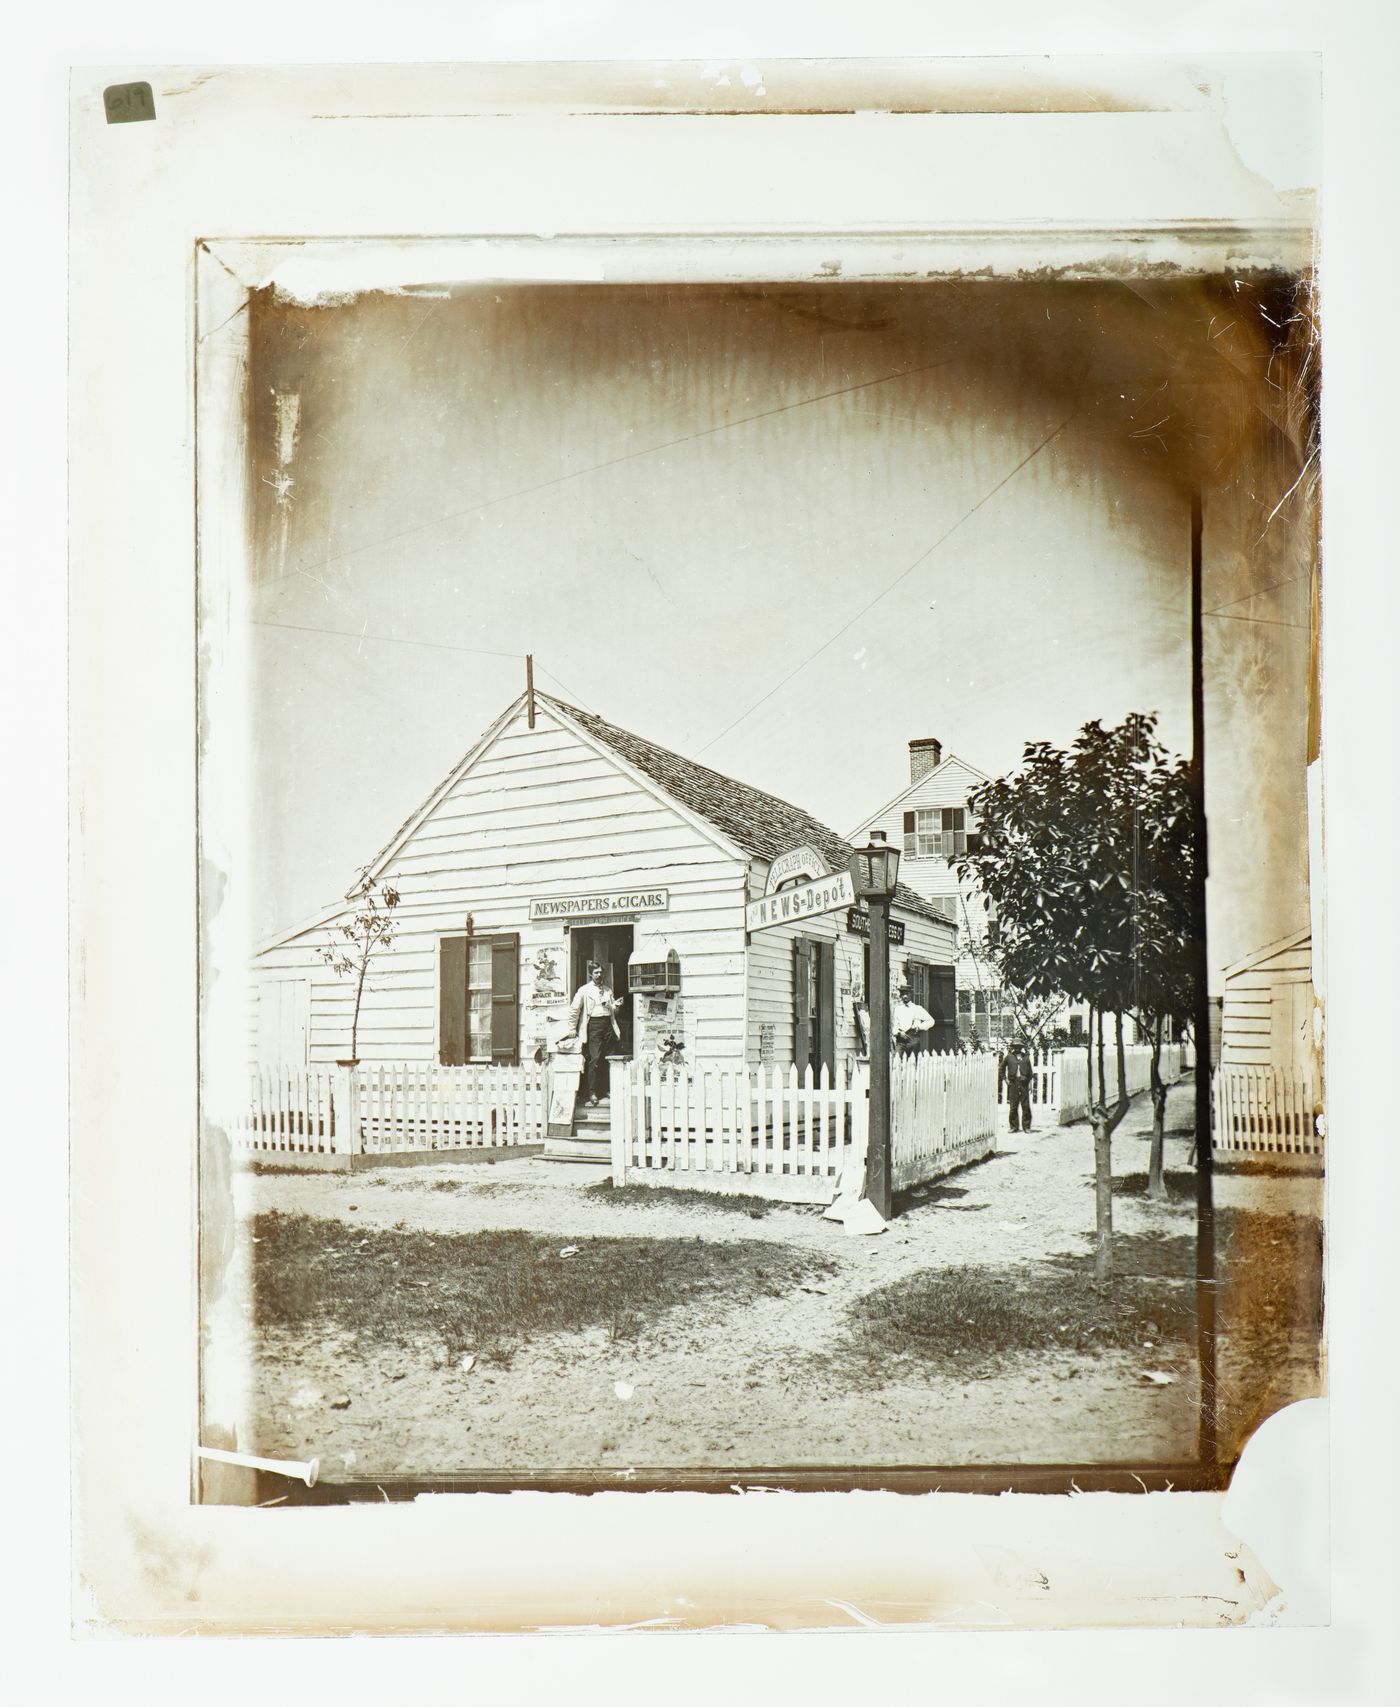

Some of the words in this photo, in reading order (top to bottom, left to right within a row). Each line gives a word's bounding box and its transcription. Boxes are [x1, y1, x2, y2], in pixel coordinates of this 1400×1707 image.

[769, 854, 801, 888] TELEGRAPH
[801, 852, 821, 877] OFFICE
[534, 897, 610, 916] NEWSPAPERS
[617, 893, 665, 909] CIGARS.
[852, 913, 871, 933] SOUTHE
